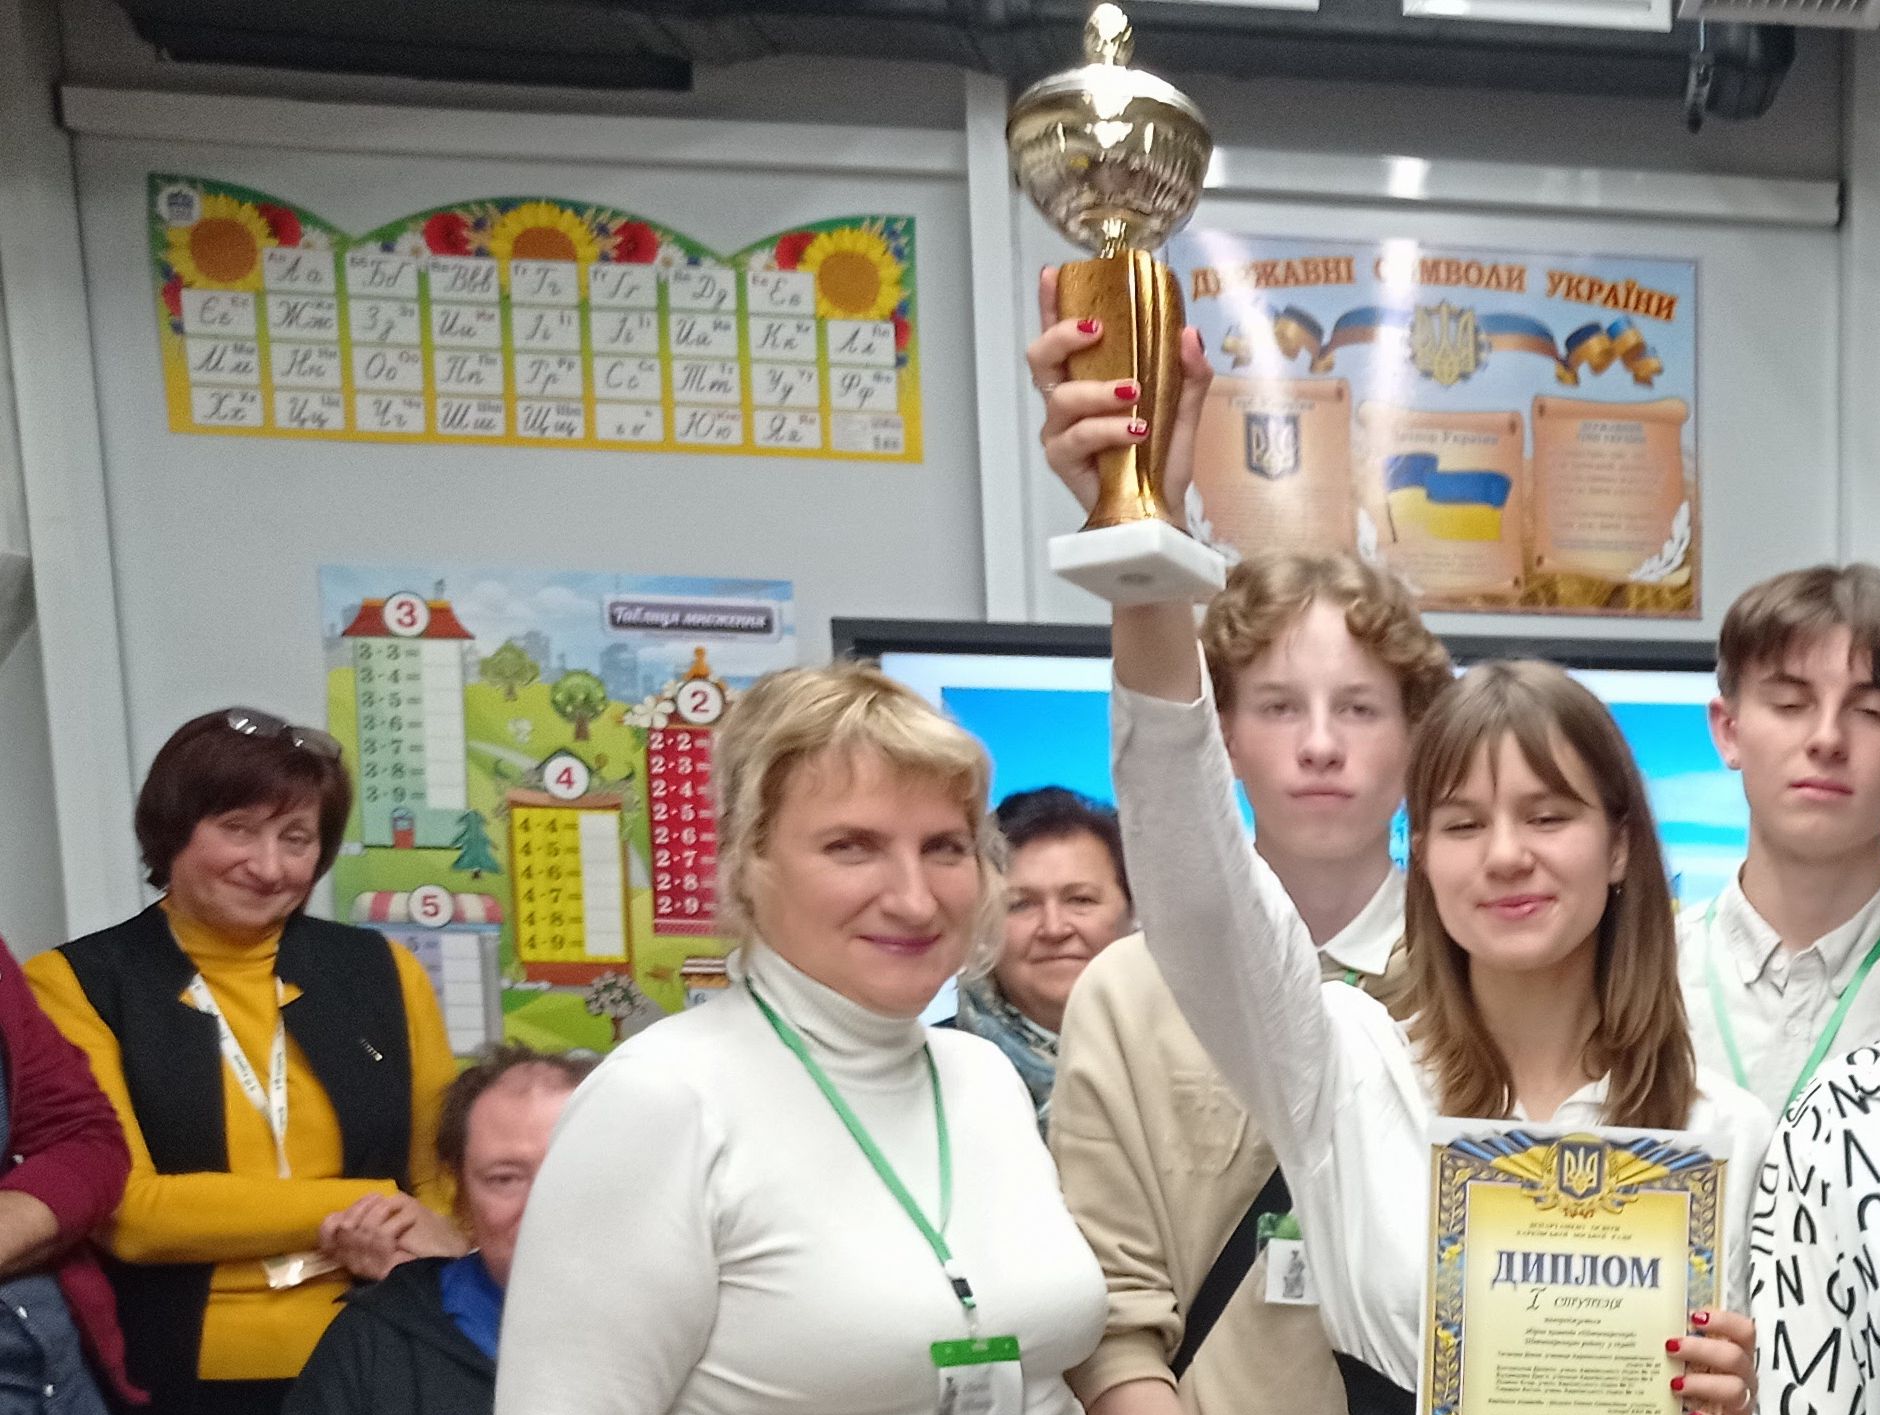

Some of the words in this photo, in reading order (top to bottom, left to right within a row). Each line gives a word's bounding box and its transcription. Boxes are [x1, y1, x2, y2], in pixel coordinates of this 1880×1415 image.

[1190, 256, 1357, 302] ДЖАВНІ
[1546, 269, 1680, 323] УКРАЇНИ
[396, 599, 418, 628] 3
[690, 690, 711, 714] 2
[555, 766, 577, 791] 4
[422, 894, 440, 918] 5
[1491, 1250, 1662, 1291] ДИПЛОМ
